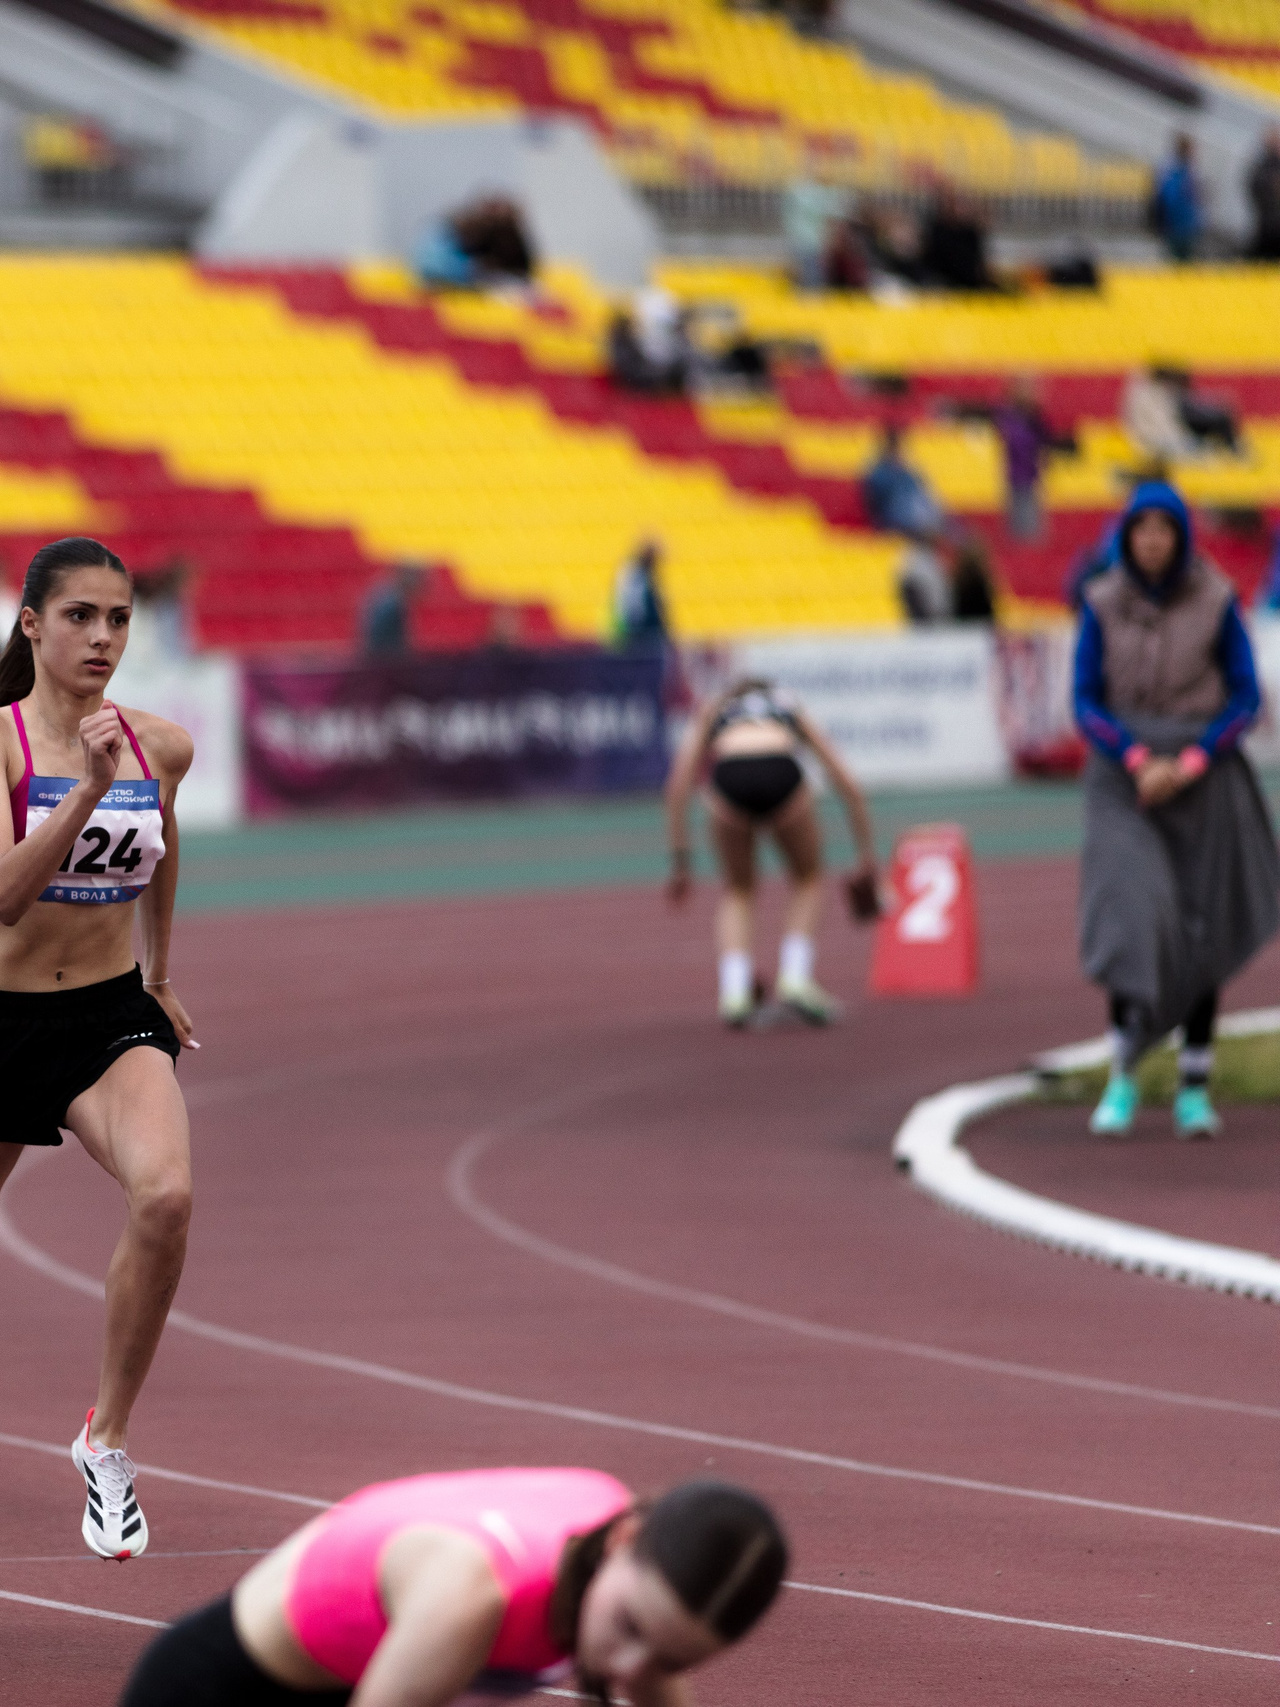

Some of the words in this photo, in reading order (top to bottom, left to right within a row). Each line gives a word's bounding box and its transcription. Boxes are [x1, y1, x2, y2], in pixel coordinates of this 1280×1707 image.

[38, 793, 67, 801] ФЕД
[70, 890, 107, 901] ВФЛА
[899, 858, 959, 941] 2
